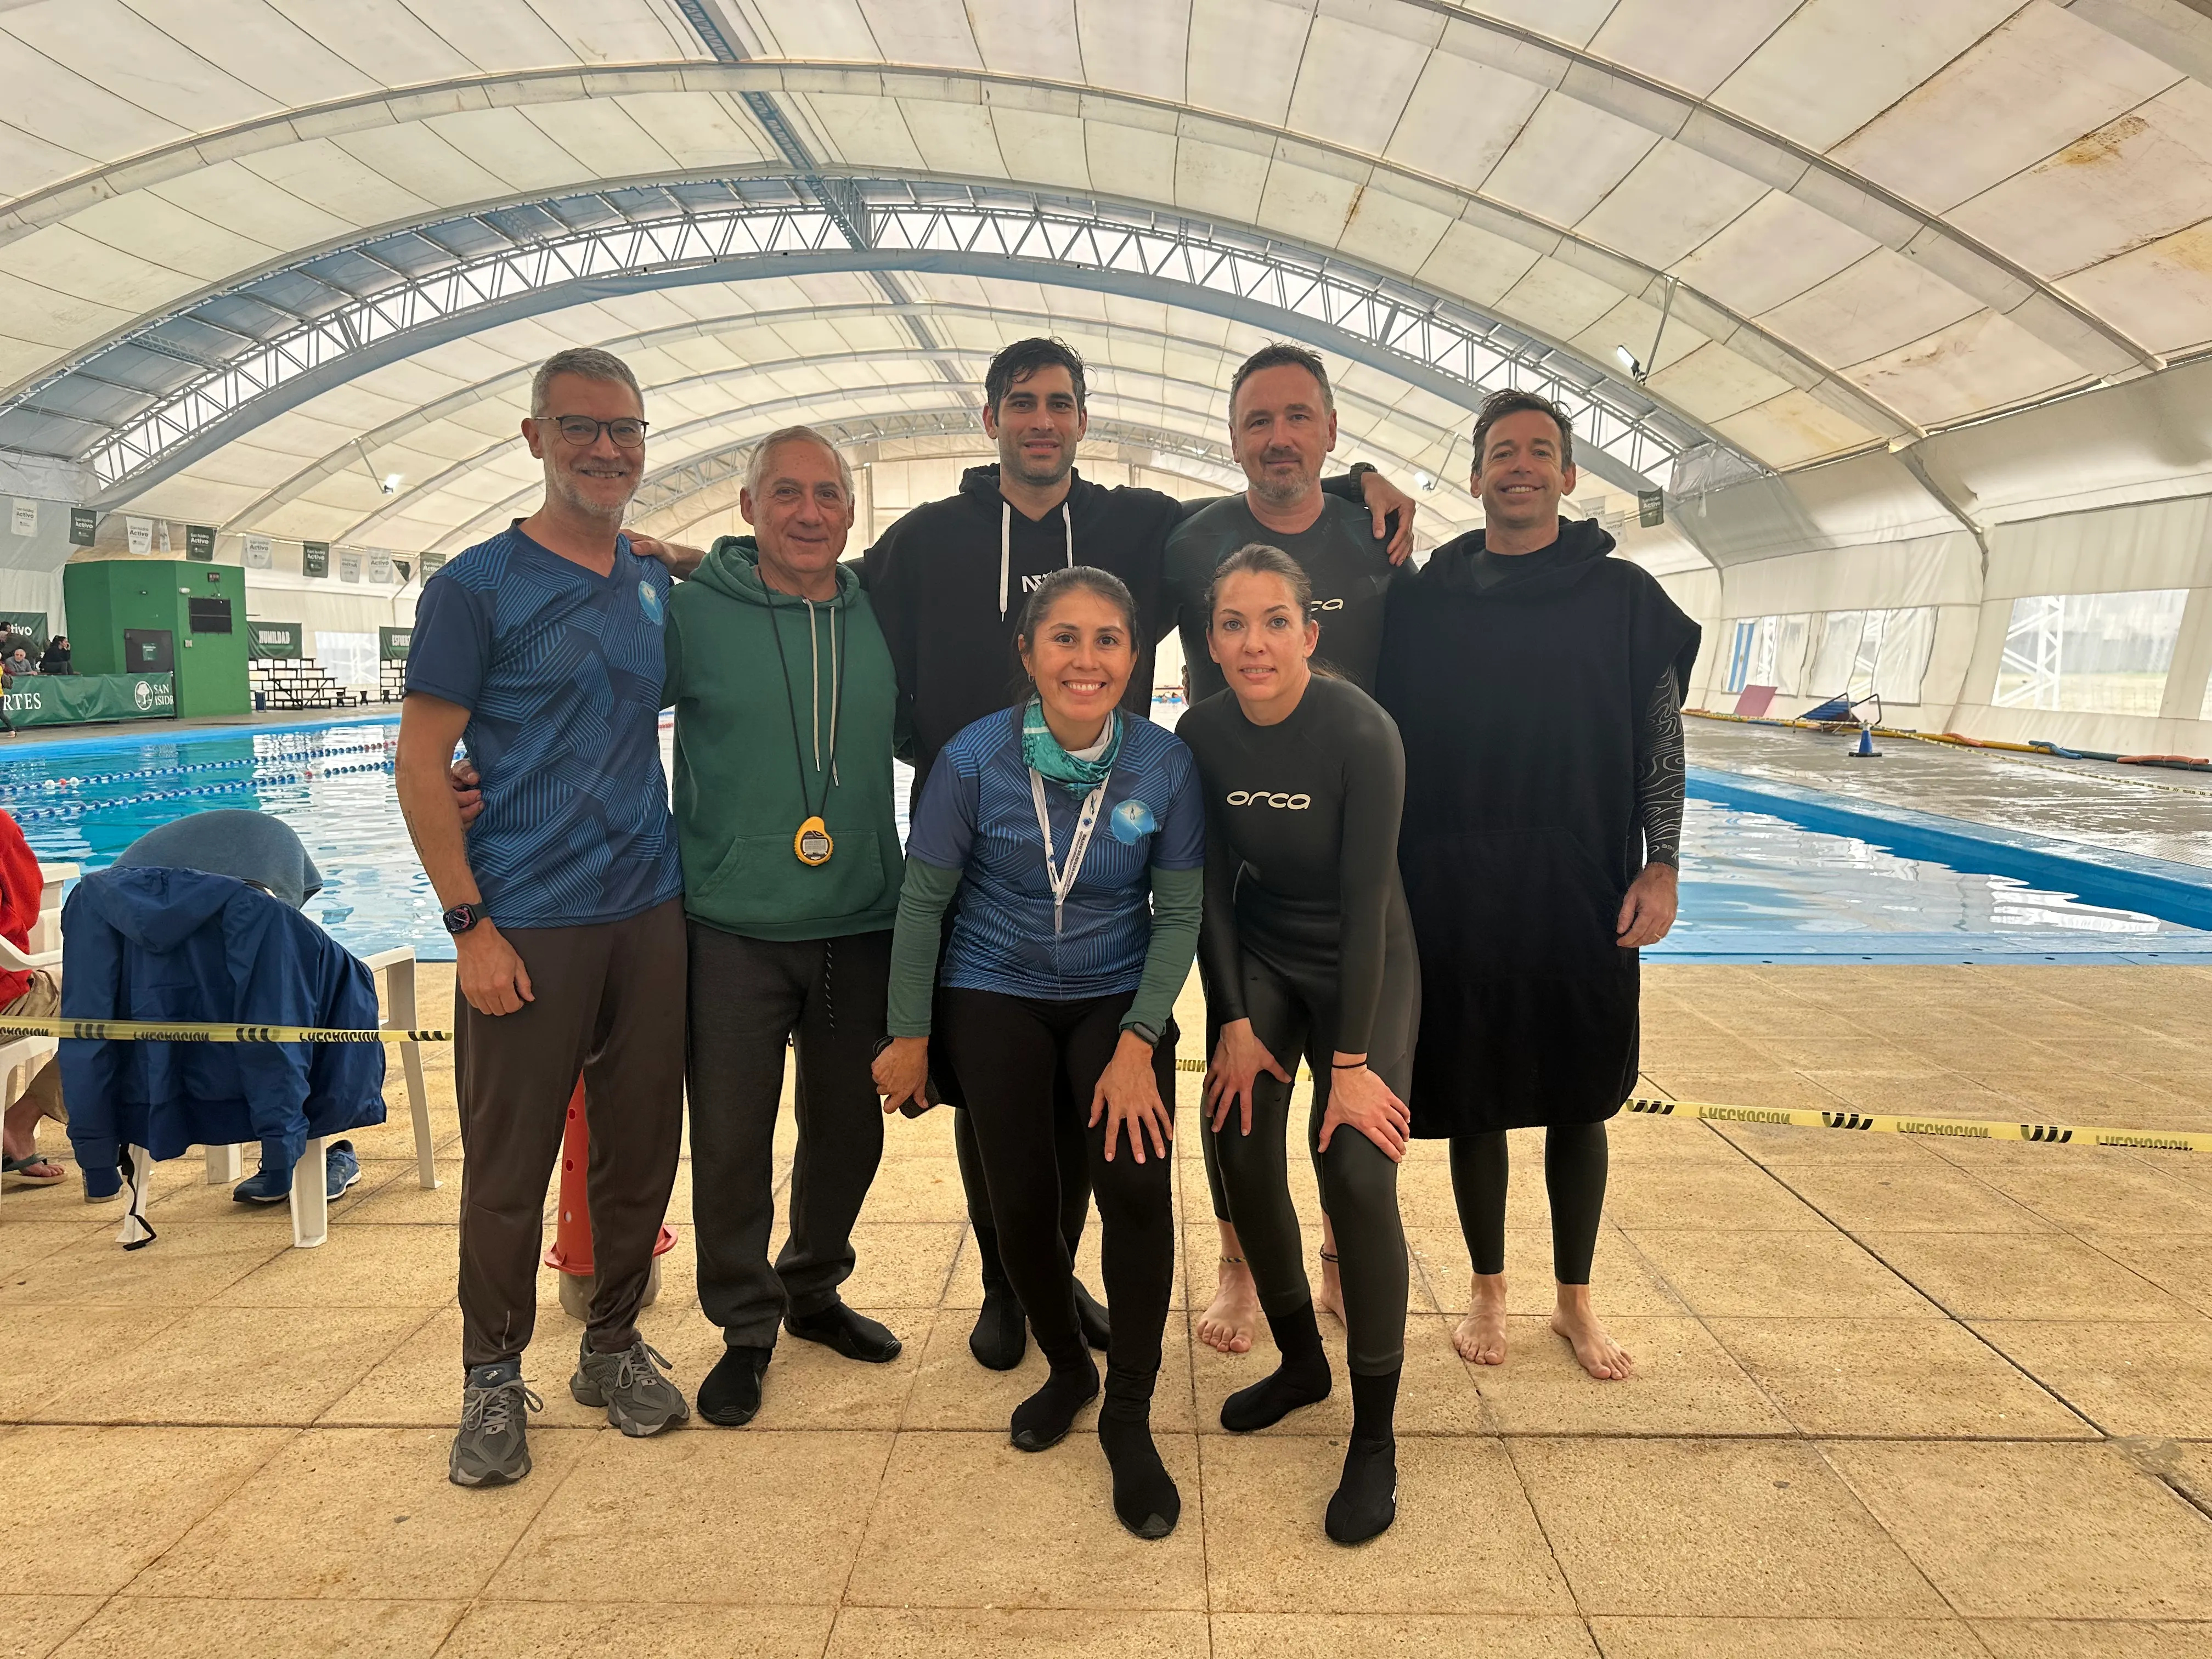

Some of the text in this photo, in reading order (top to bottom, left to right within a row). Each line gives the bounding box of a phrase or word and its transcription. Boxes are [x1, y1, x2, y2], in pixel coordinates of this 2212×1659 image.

[1311, 598, 1344, 612] ca
[11, 623, 32, 636] tivo
[259, 630, 290, 644] HUMILDAD
[154, 684, 169, 695] SAN
[3, 692, 42, 711] RTES
[155, 695, 174, 706] ISIDR
[1227, 791, 1311, 810] orca
